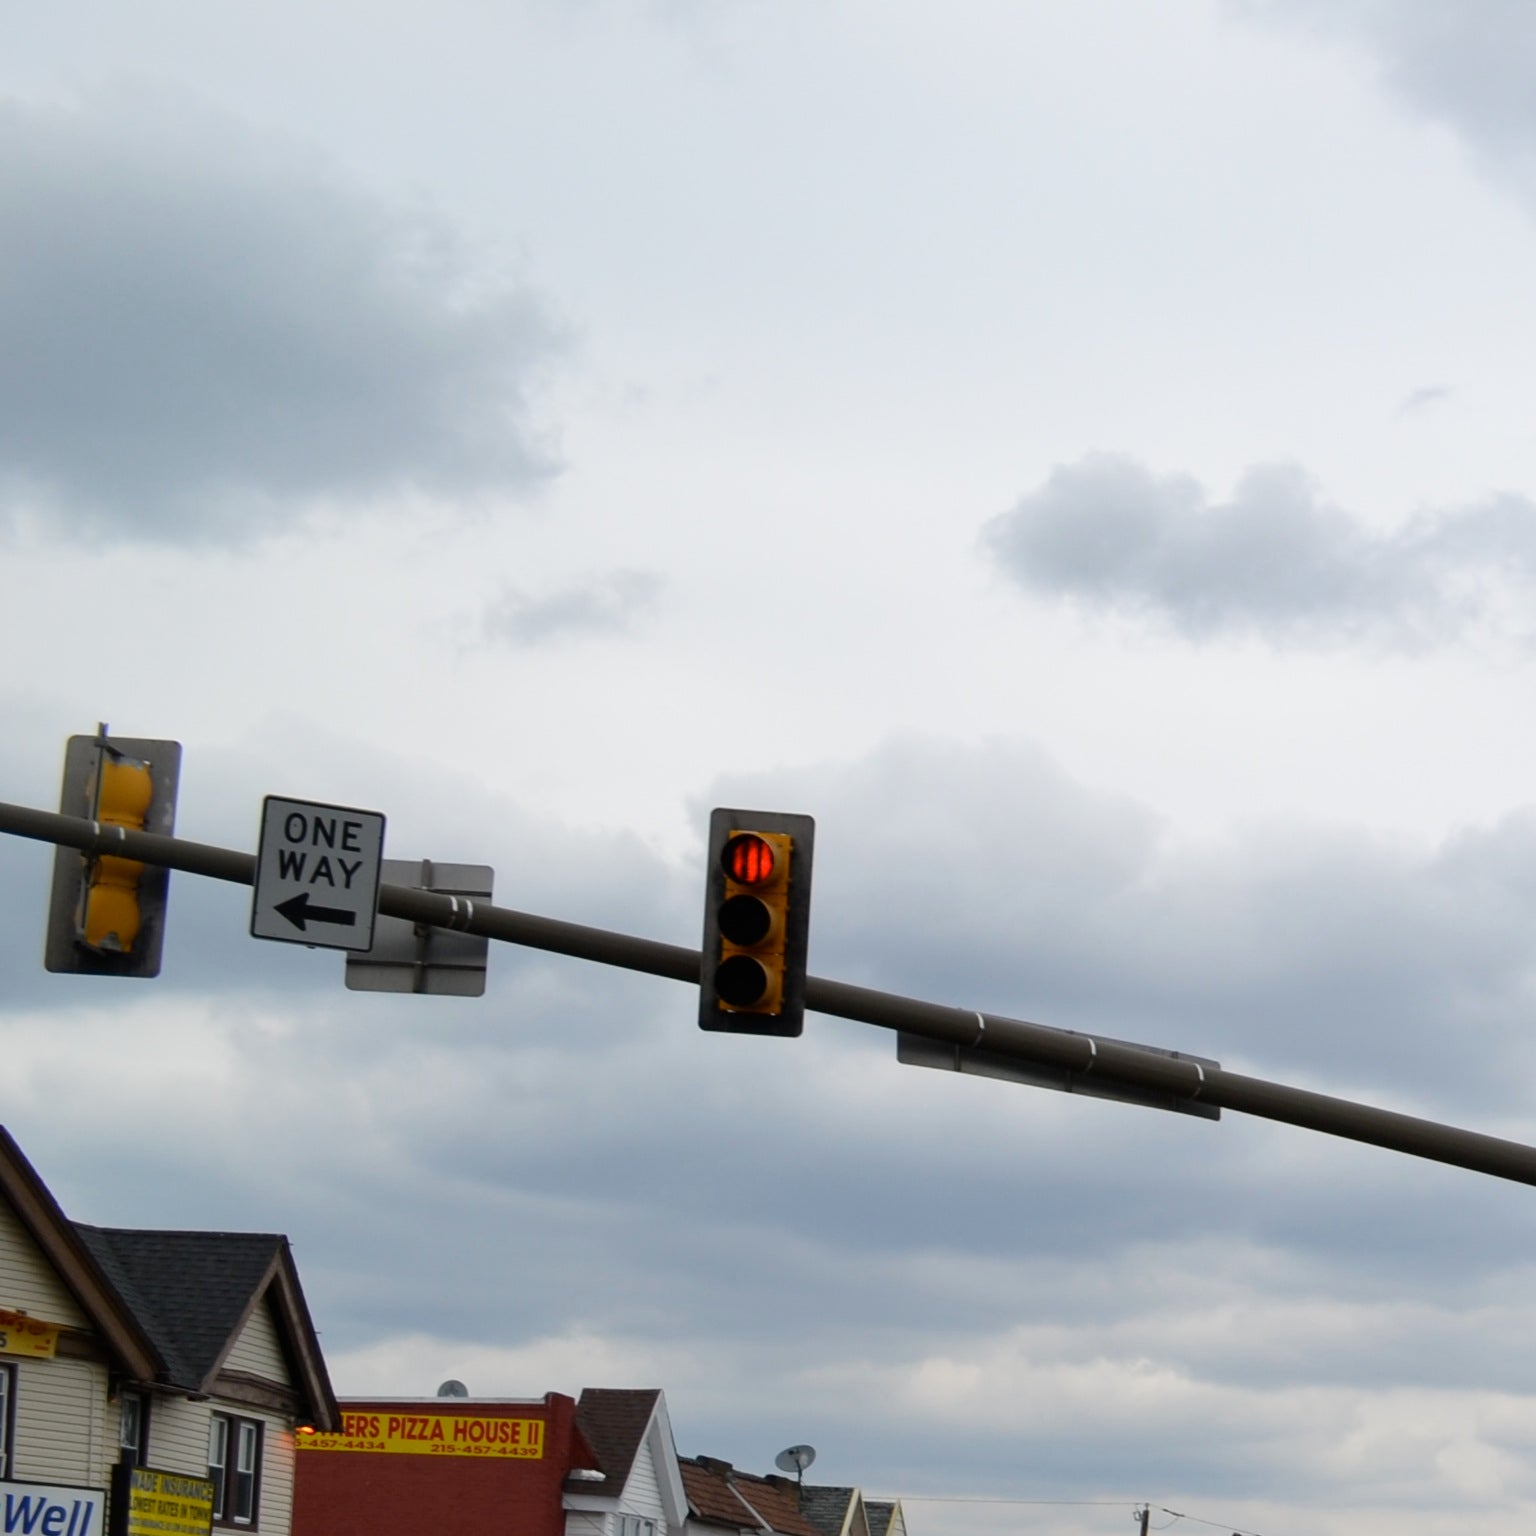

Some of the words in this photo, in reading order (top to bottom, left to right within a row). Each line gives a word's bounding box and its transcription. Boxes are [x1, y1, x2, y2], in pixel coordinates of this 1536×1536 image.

[284, 812, 363, 853] ONE
[278, 849, 363, 889] WAY
[388, 1417, 444, 1441] PIZZA
[454, 1420, 520, 1444] HOUSE
[527, 1422, 540, 1445] II
[295, 1438, 386, 1450] 5-457-4434
[431, 1444, 538, 1456] 215-457-4439
[161, 1477, 213, 1502] INSURANCE
[157, 1500, 180, 1517] RATES
